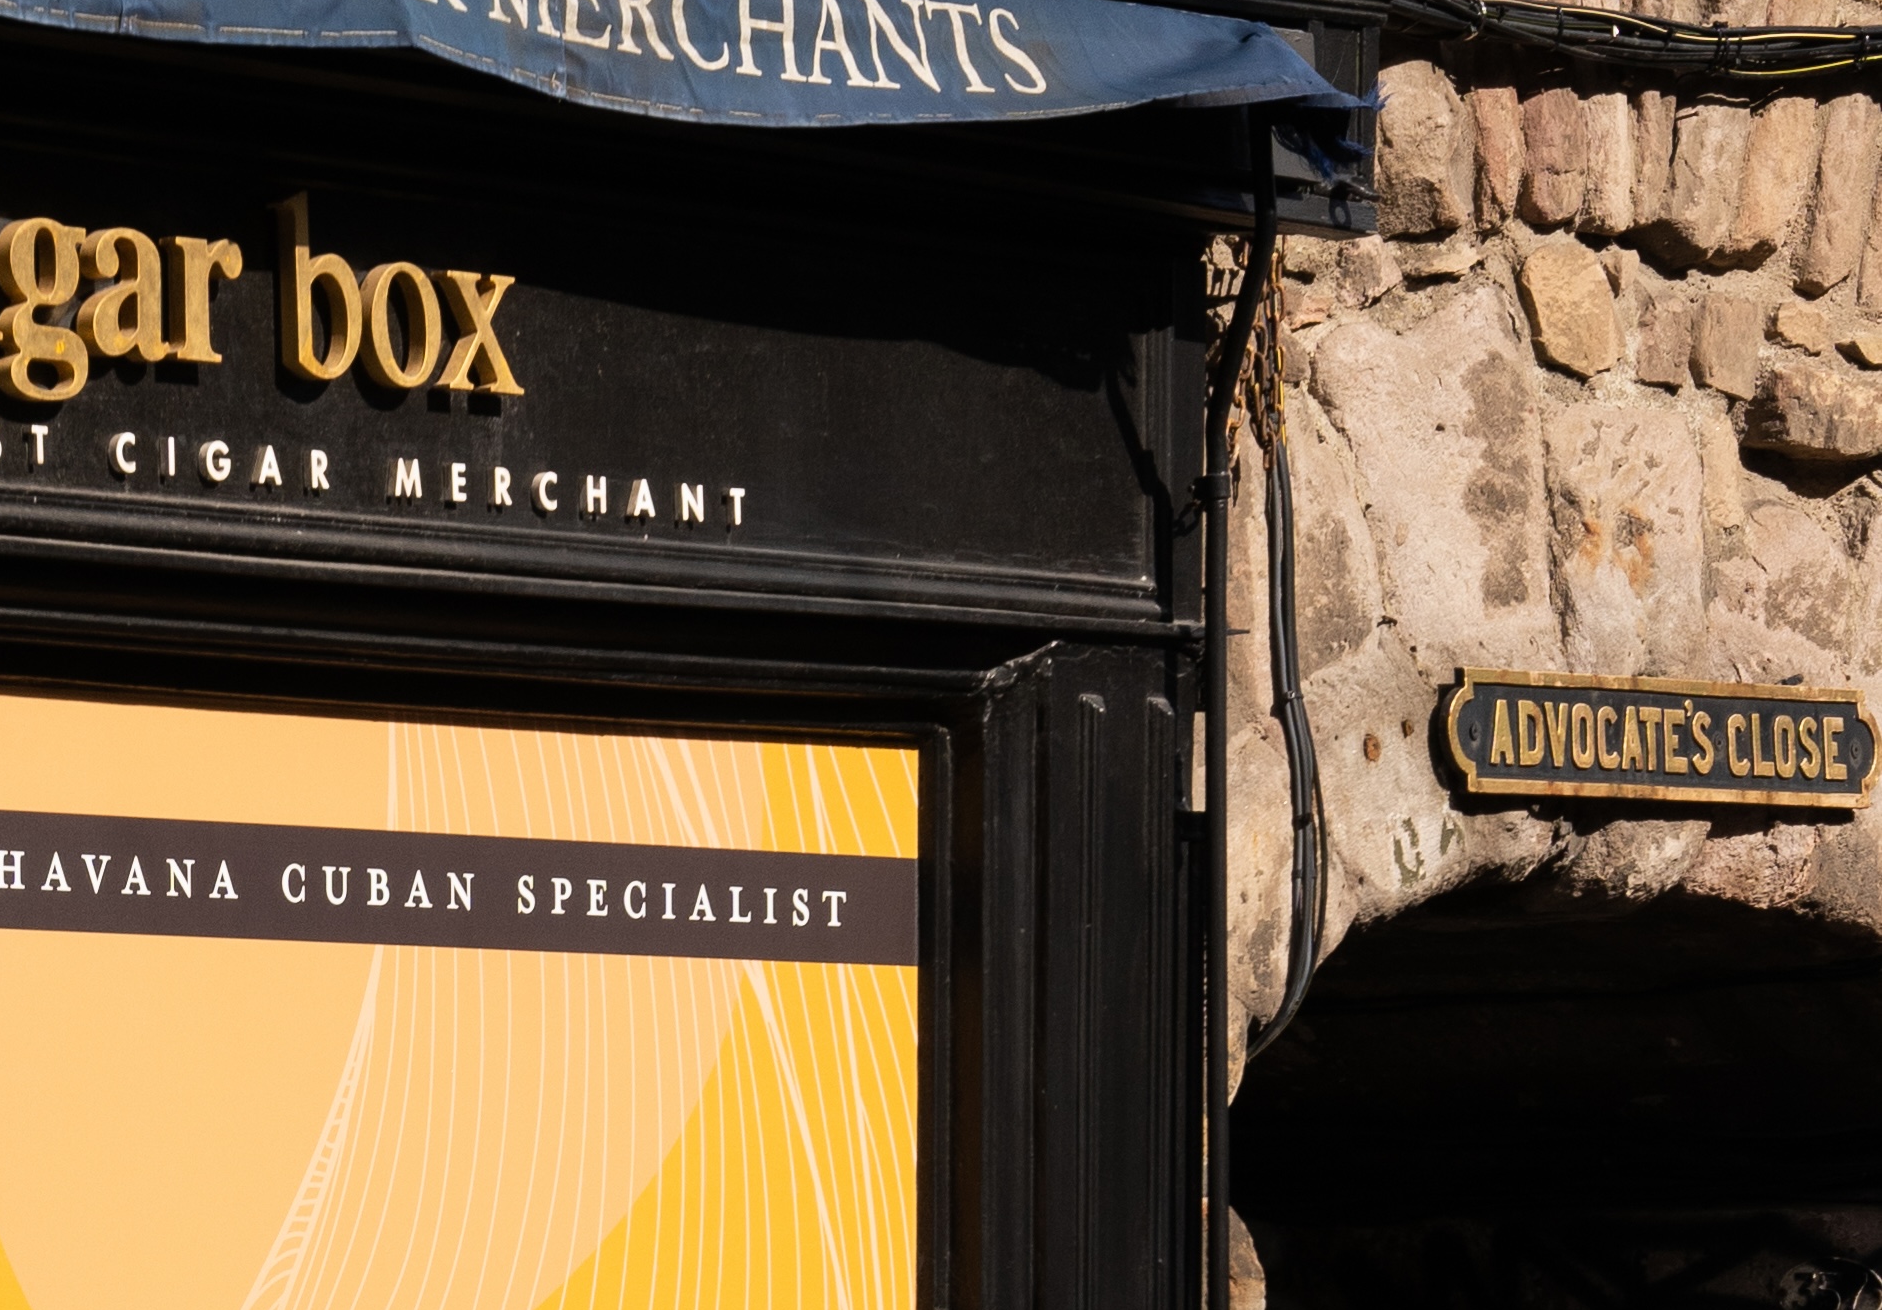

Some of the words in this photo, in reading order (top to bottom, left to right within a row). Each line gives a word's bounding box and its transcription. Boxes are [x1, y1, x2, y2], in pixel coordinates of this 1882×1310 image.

[276, 190, 526, 397] box
[109, 431, 330, 499] CIGAR
[393, 457, 746, 527] MERCHANT
[1490, 699, 1715, 775] ADVOCATE'S
[1727, 713, 1848, 781] CLOSE
[281, 862, 475, 912] CUBAN
[517, 874, 848, 928] SPECIALIST
